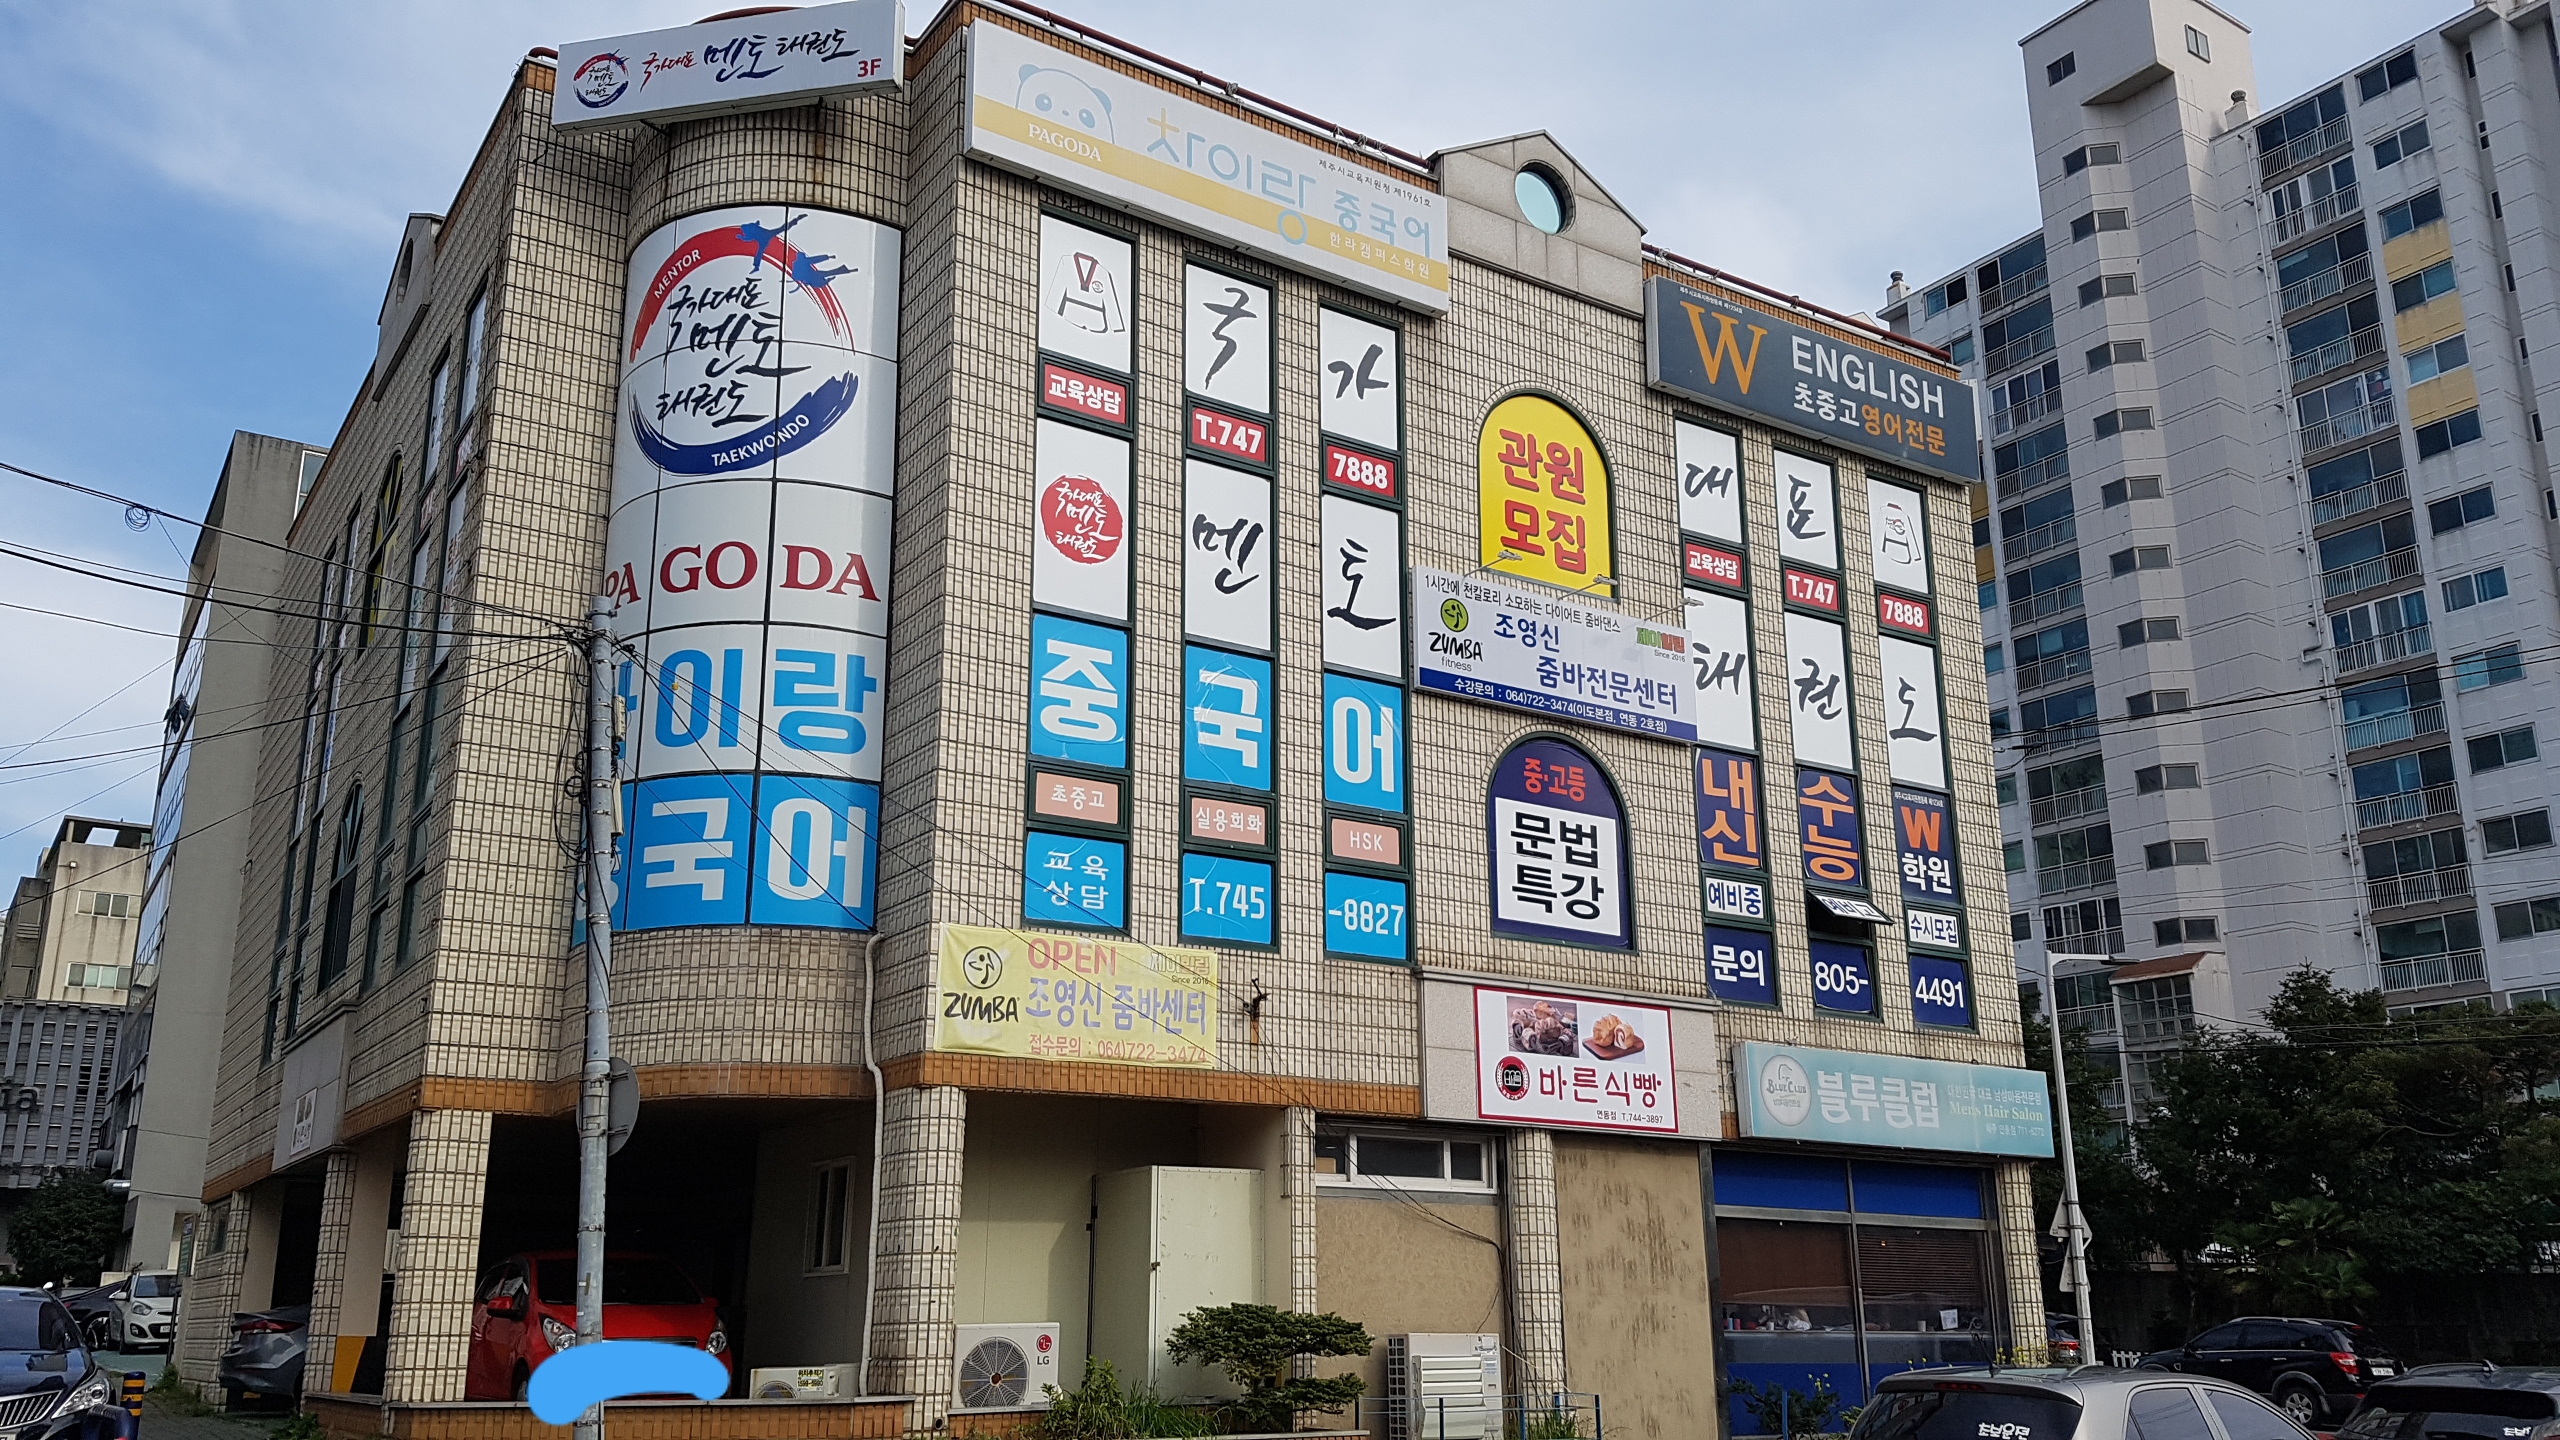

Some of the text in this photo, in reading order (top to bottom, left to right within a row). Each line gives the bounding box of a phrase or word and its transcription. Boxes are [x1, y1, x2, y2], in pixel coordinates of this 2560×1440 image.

[640, 29, 860, 93] 국가대표 멘토 태권도
[857, 58, 882, 77] 3F
[1027, 122, 1102, 162] PAGODA
[1147, 108, 1317, 246] 차이랑
[1318, 159, 1432, 208] 제주시교육지원청 제1961호
[1334, 189, 1430, 259] 중국어
[654, 249, 701, 299] MENTOR
[1329, 231, 1429, 279] 한라캠퍼스학원
[667, 277, 769, 350] 국가대표
[690, 312, 811, 377] 멘토
[1203, 287, 1390, 400] 국 가
[1680, 300, 1944, 418] W ENGLISH
[655, 380, 769, 428] 태권도
[1048, 373, 1122, 416] 교육상담
[1195, 413, 1262, 455] T.747
[1793, 381, 1945, 456] 초중고영어전문
[711, 414, 810, 467] TAEKWONDO
[1332, 452, 1388, 489] 7888
[1498, 428, 1586, 505] 관원
[1055, 481, 1107, 518] 국가대표
[1684, 462, 1826, 539] 대 표
[1066, 503, 1119, 541] 멘토
[1500, 499, 1587, 575] 모집
[1055, 531, 1106, 559] 태권도
[1689, 551, 1738, 580] 교육상담
[1192, 513, 1396, 630] 멘 토
[1788, 573, 1835, 605] T.747
[1425, 574, 1621, 633] 1시간에 천칼로리 소모하는 다이어트 줌바댄스
[1884, 600, 1924, 628] 7888
[1428, 632, 1483, 662] ZUMBA
[1494, 612, 1560, 653] 조영신
[1441, 656, 1472, 673] fitness
[1654, 650, 1670, 659] Since
[1454, 678, 1494, 697] 수강문의
[1619, 713, 1637, 728] 연동
[1640, 718, 1668, 733] 2호점)
[1536, 654, 1677, 715] 줌바전문센터
[1692, 643, 1937, 742] 태 권 도
[1040, 639, 1395, 793] 중 국 어
[1051, 784, 1105, 810] 초중고
[1702, 758, 1760, 868] 내신
[1196, 806, 1262, 834] 실용회화
[1349, 830, 1383, 852] HSK
[1510, 811, 1599, 869] 문법
[1800, 775, 1859, 881] 수능
[1901, 806, 1942, 852] W
[1043, 851, 1109, 881] 교육
[1902, 852, 1952, 895] 학원
[1043, 880, 1109, 910] 상담
[1191, 877, 1265, 919] T.745
[1511, 864, 1605, 920] 특강
[1708, 881, 1761, 917] 예비중
[1822, 898, 1882, 918] 예비고
[1328, 898, 1404, 937] -8827
[1910, 913, 1958, 944] 수시모집
[1028, 938, 1116, 976] OPEN
[1711, 944, 1765, 987] 문의
[1815, 961, 1868, 995] 805-
[1172, 975, 1190, 984] Since
[1915, 975, 1964, 1008] 4491
[943, 992, 1019, 1023] ZUMBA
[1025, 977, 1207, 1036] 조영신 줌바센터
[1029, 1034, 1083, 1058] 접수문의
[1098, 1038, 1207, 1063] 064)722-3474
[1540, 1065, 1662, 1108] 바른식빵
[1816, 1070, 1940, 1129] 블루클럽
[1596, 1110, 1663, 1124] 연동점 T.744-3897
[1984, 1104, 2010, 1119] Hair
[2011, 1106, 2043, 1121] Salon
[1037, 1355, 1050, 1366] LG
